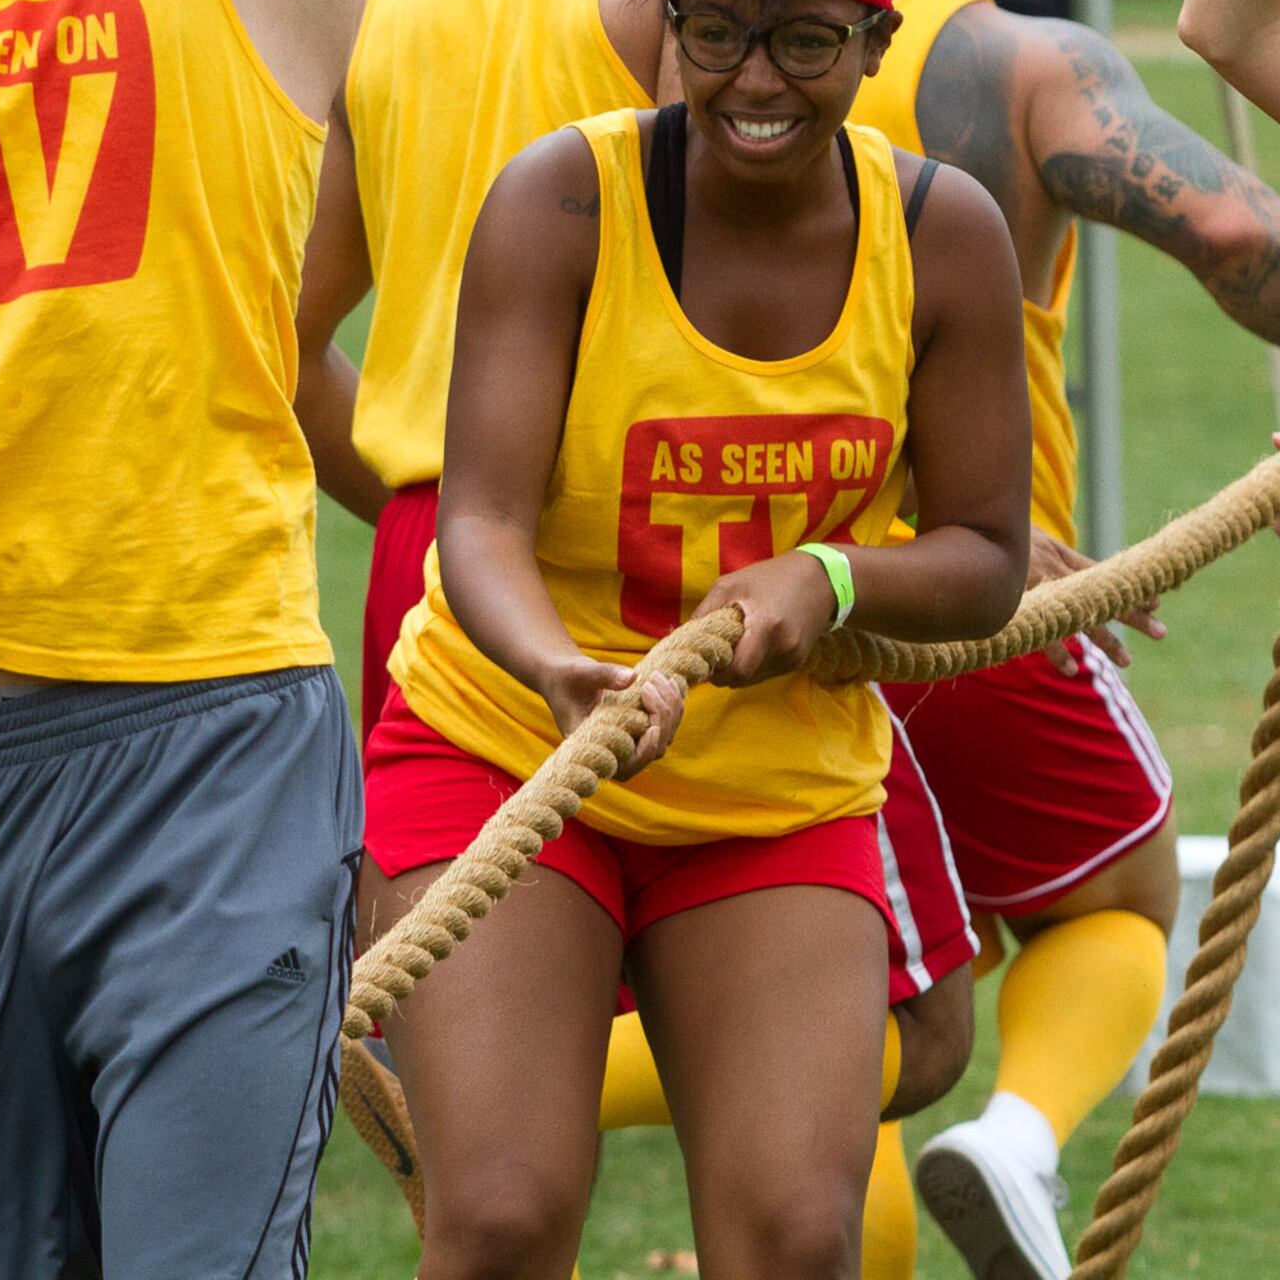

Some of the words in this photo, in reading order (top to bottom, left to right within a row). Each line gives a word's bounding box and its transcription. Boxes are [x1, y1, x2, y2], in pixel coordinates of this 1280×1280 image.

[56, 12, 118, 64] ON
[650, 440, 703, 484] AS
[720, 440, 813, 485] SEEN
[830, 439, 876, 480] ON
[266, 966, 306, 983] adidas
